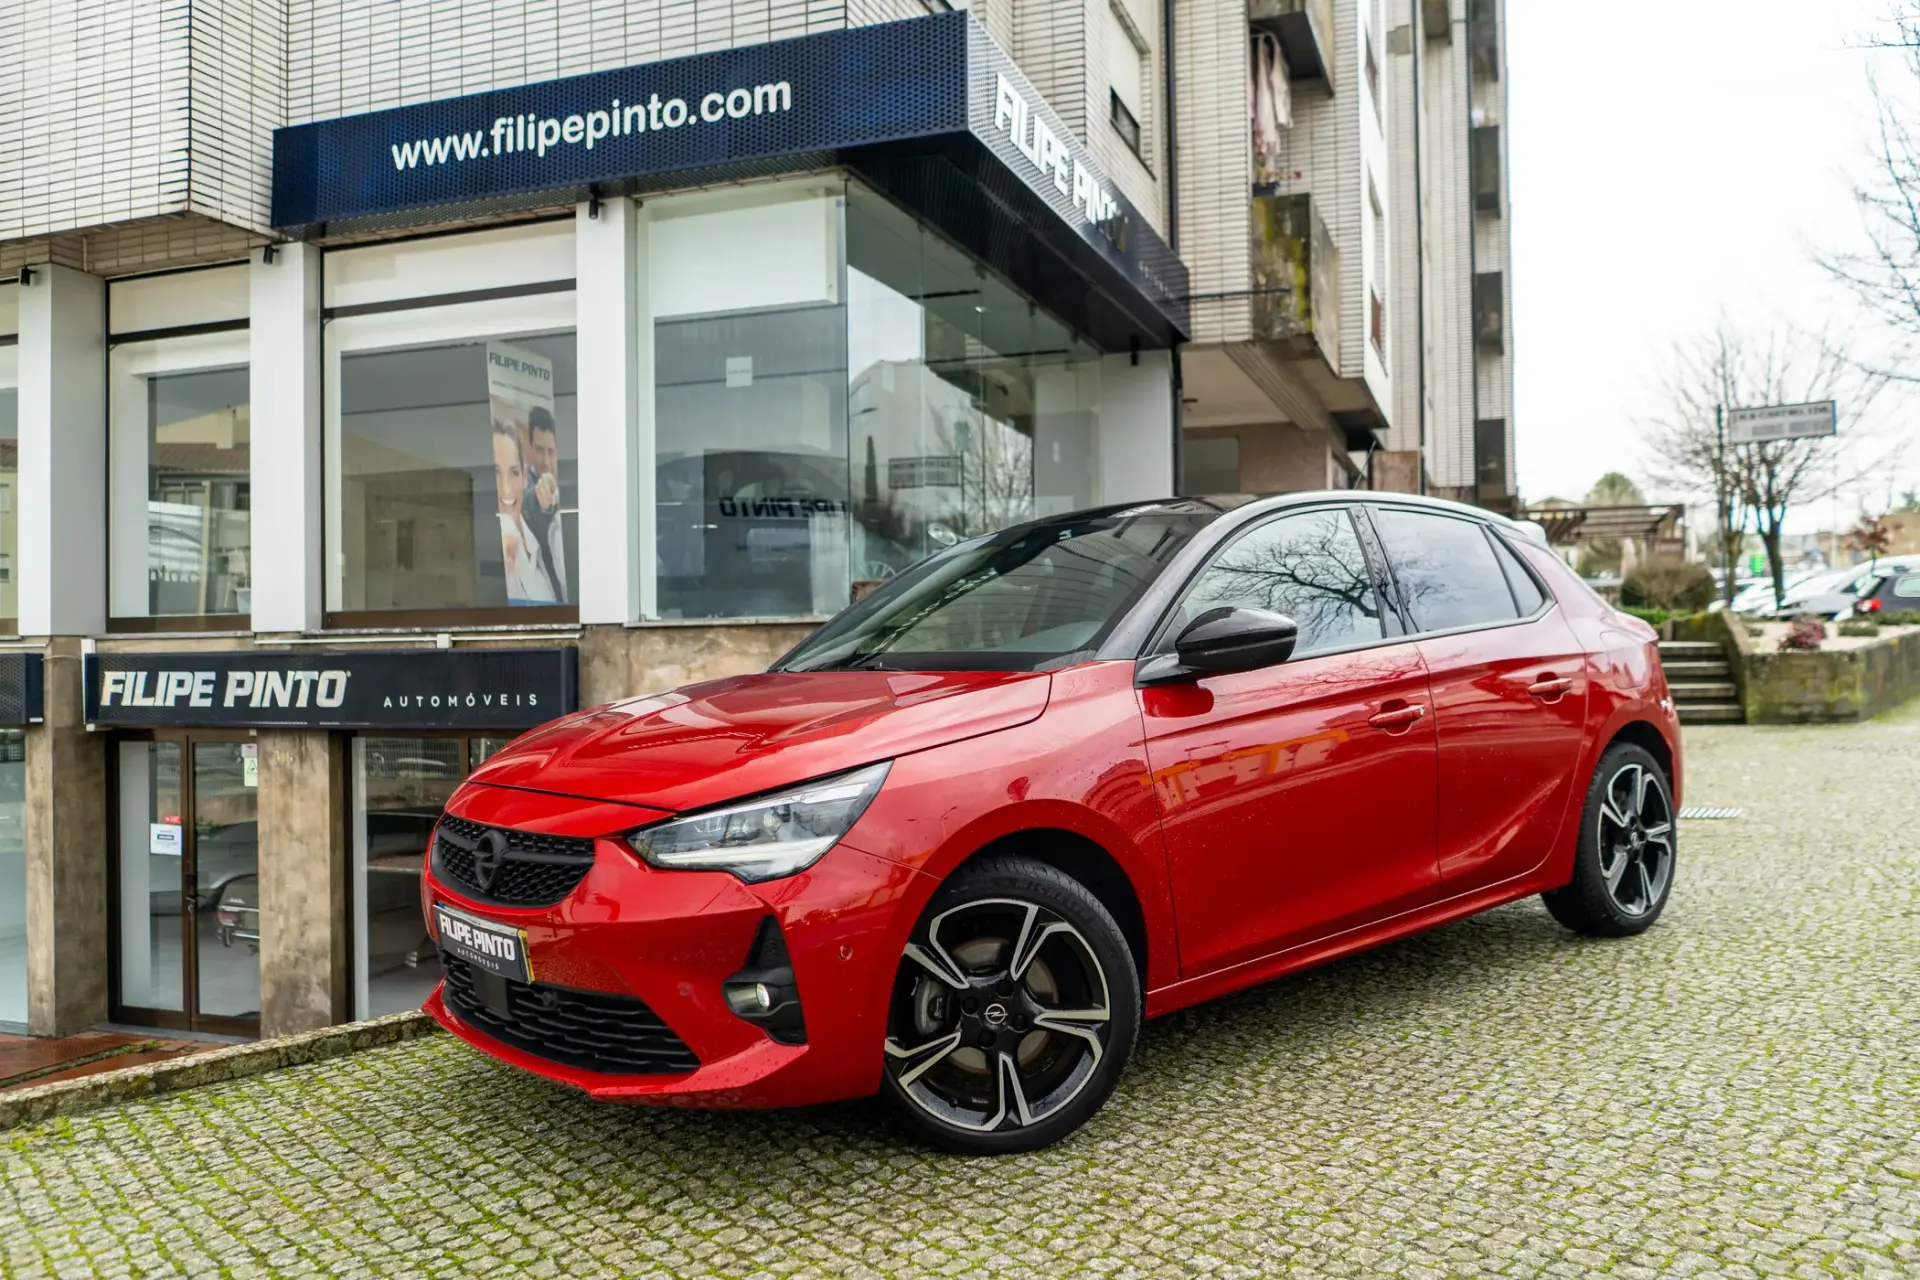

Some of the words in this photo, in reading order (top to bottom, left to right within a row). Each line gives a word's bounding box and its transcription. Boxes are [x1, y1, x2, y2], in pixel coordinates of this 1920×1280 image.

[391, 80, 793, 171] www.filipepinto.com
[994, 71, 1070, 196] FILIPE
[489, 351, 521, 372] FILIPE
[521, 362, 551, 382] PINTO
[100, 671, 217, 707] FILIPE
[223, 670, 350, 708] PINTO
[383, 692, 538, 708] AUTOMÓVEIS
[439, 912, 473, 946] FILIPE
[472, 928, 516, 961] PINTO
